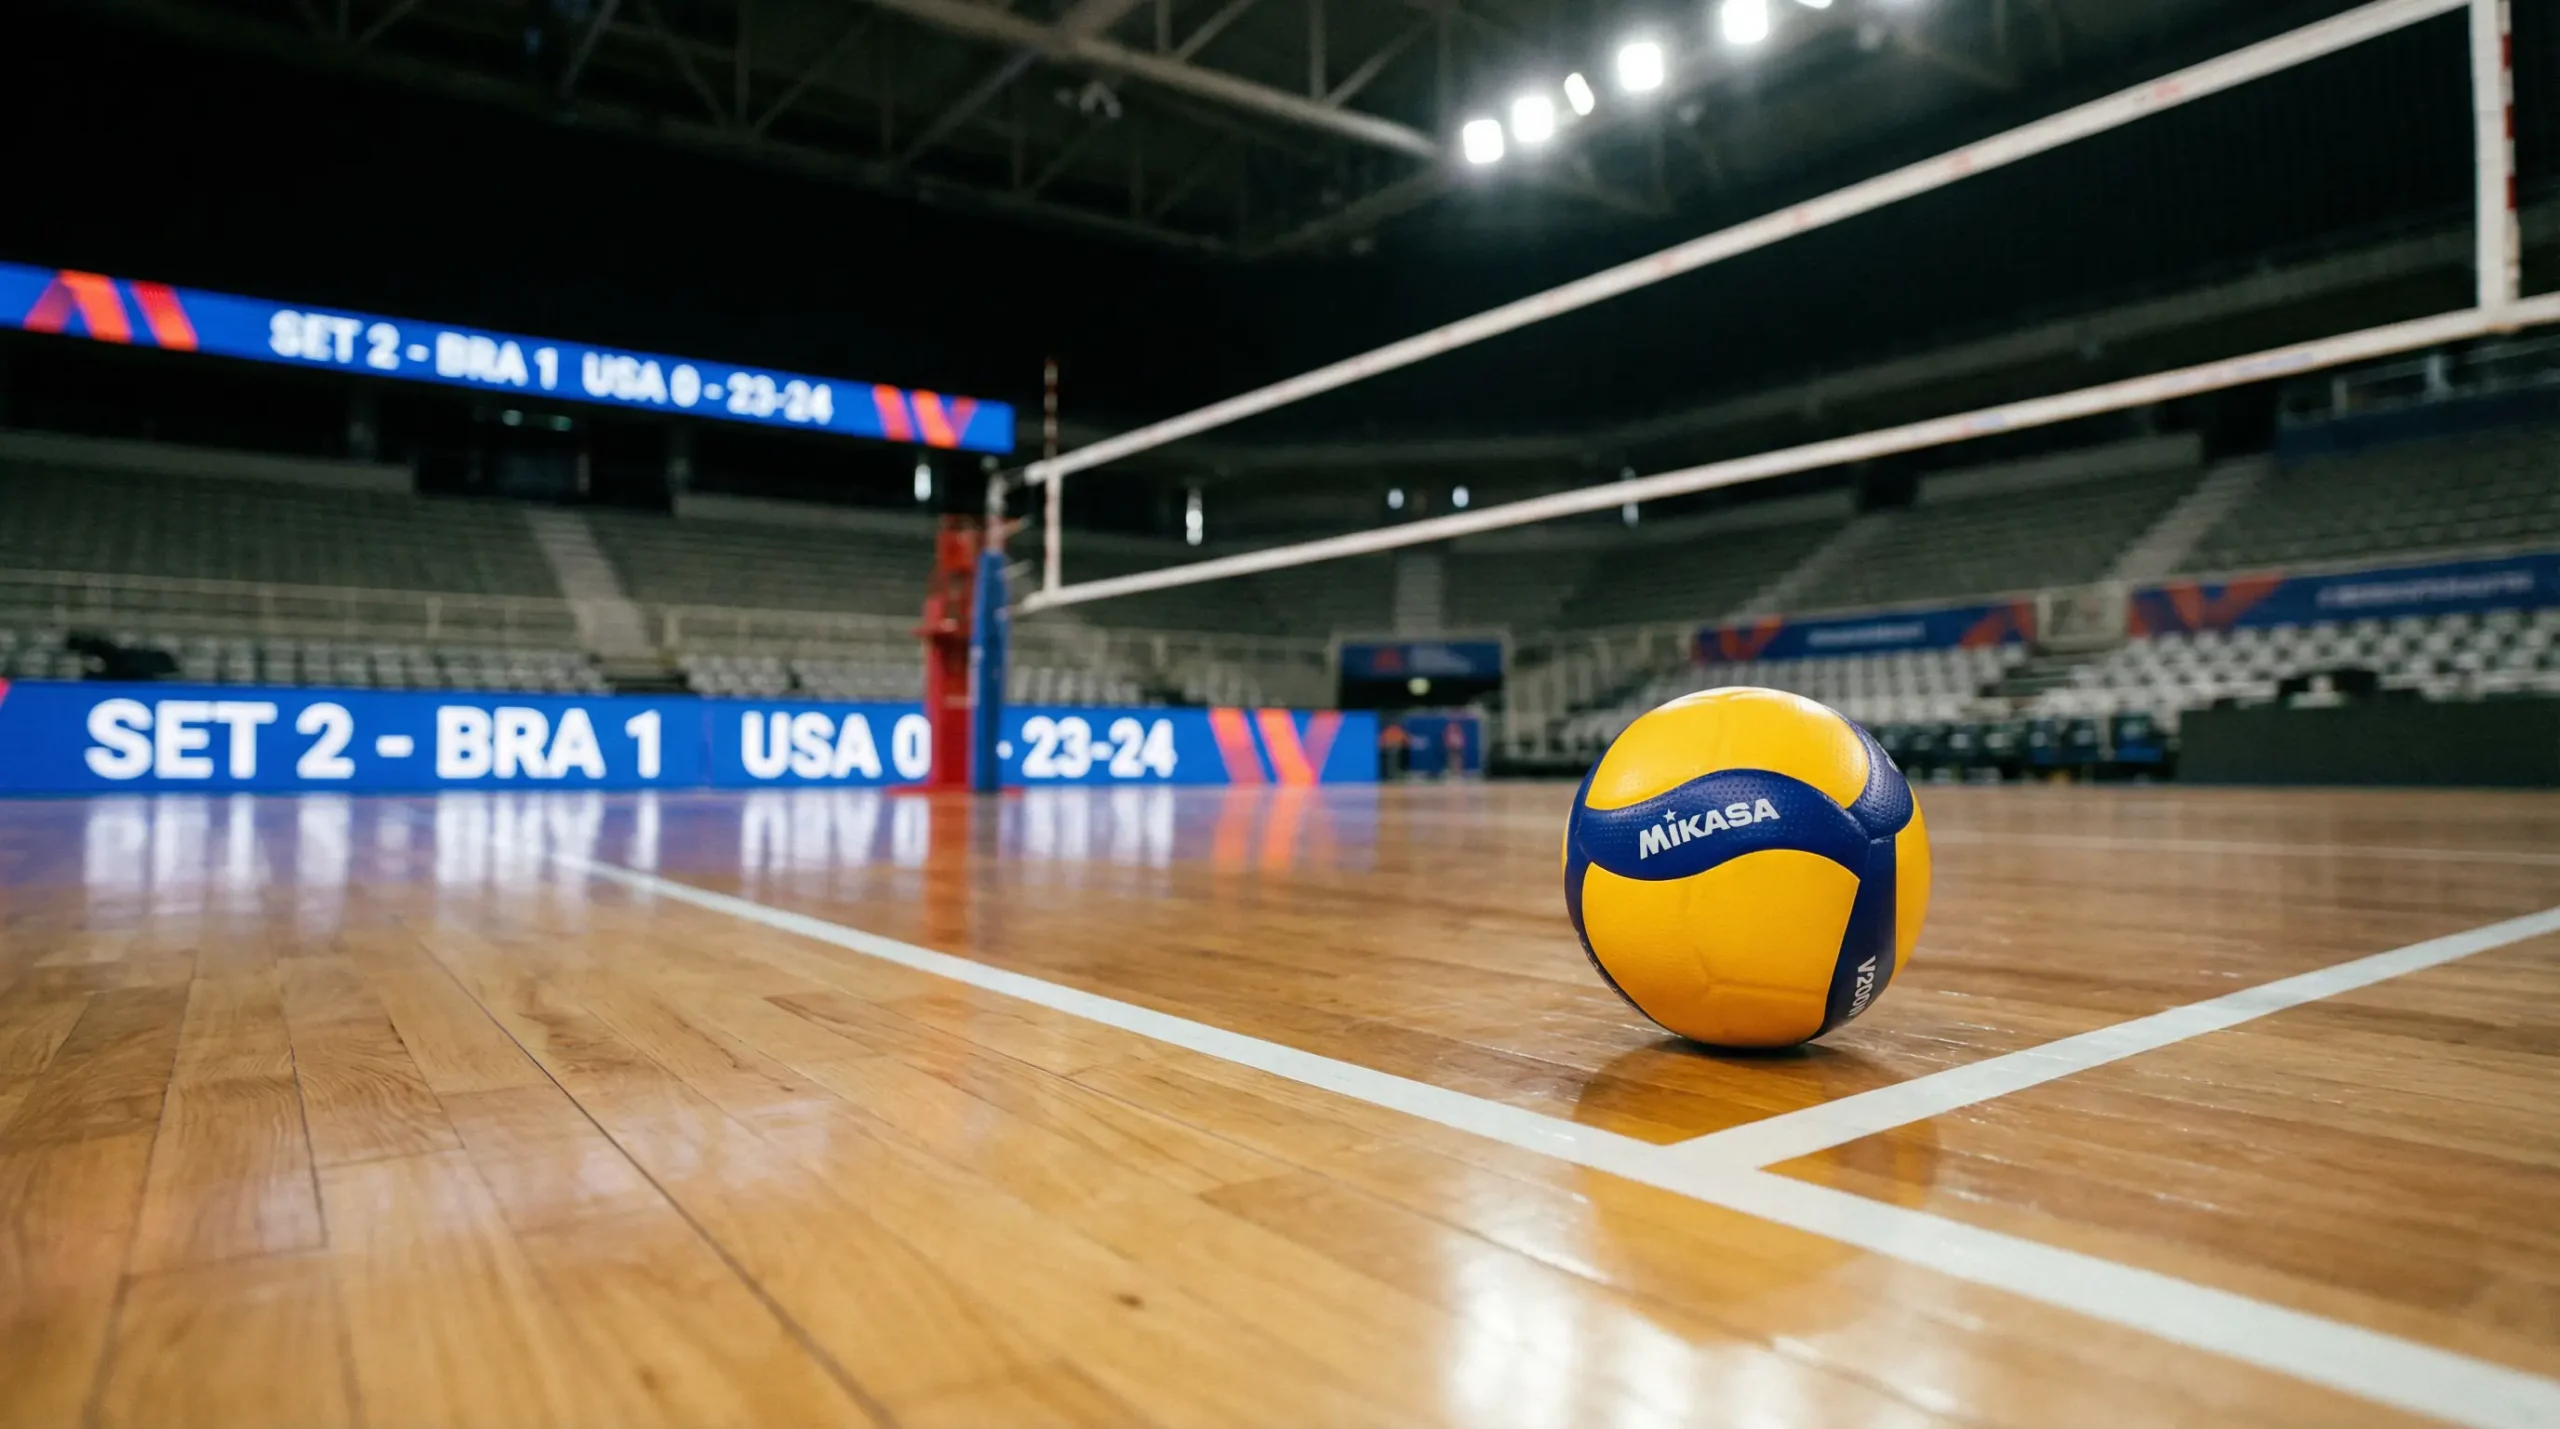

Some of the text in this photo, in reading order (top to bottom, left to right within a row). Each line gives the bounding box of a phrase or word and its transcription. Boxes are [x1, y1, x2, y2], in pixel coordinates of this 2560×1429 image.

[270, 310, 362, 363] SET
[367, 323, 399, 370] 2
[407, 344, 429, 362] -
[436, 332, 528, 386] BRA
[534, 347, 558, 389] 1
[582, 353, 667, 403] USA
[670, 364, 700, 407] 0
[85, 698, 278, 779] SET
[296, 702, 355, 779] 2
[375, 735, 414, 758] -
[436, 705, 606, 779] BRA
[625, 710, 661, 779] 1
[741, 711, 882, 779] USA
[892, 713, 932, 779] 0
[1021, 715, 1178, 778] 23-24
